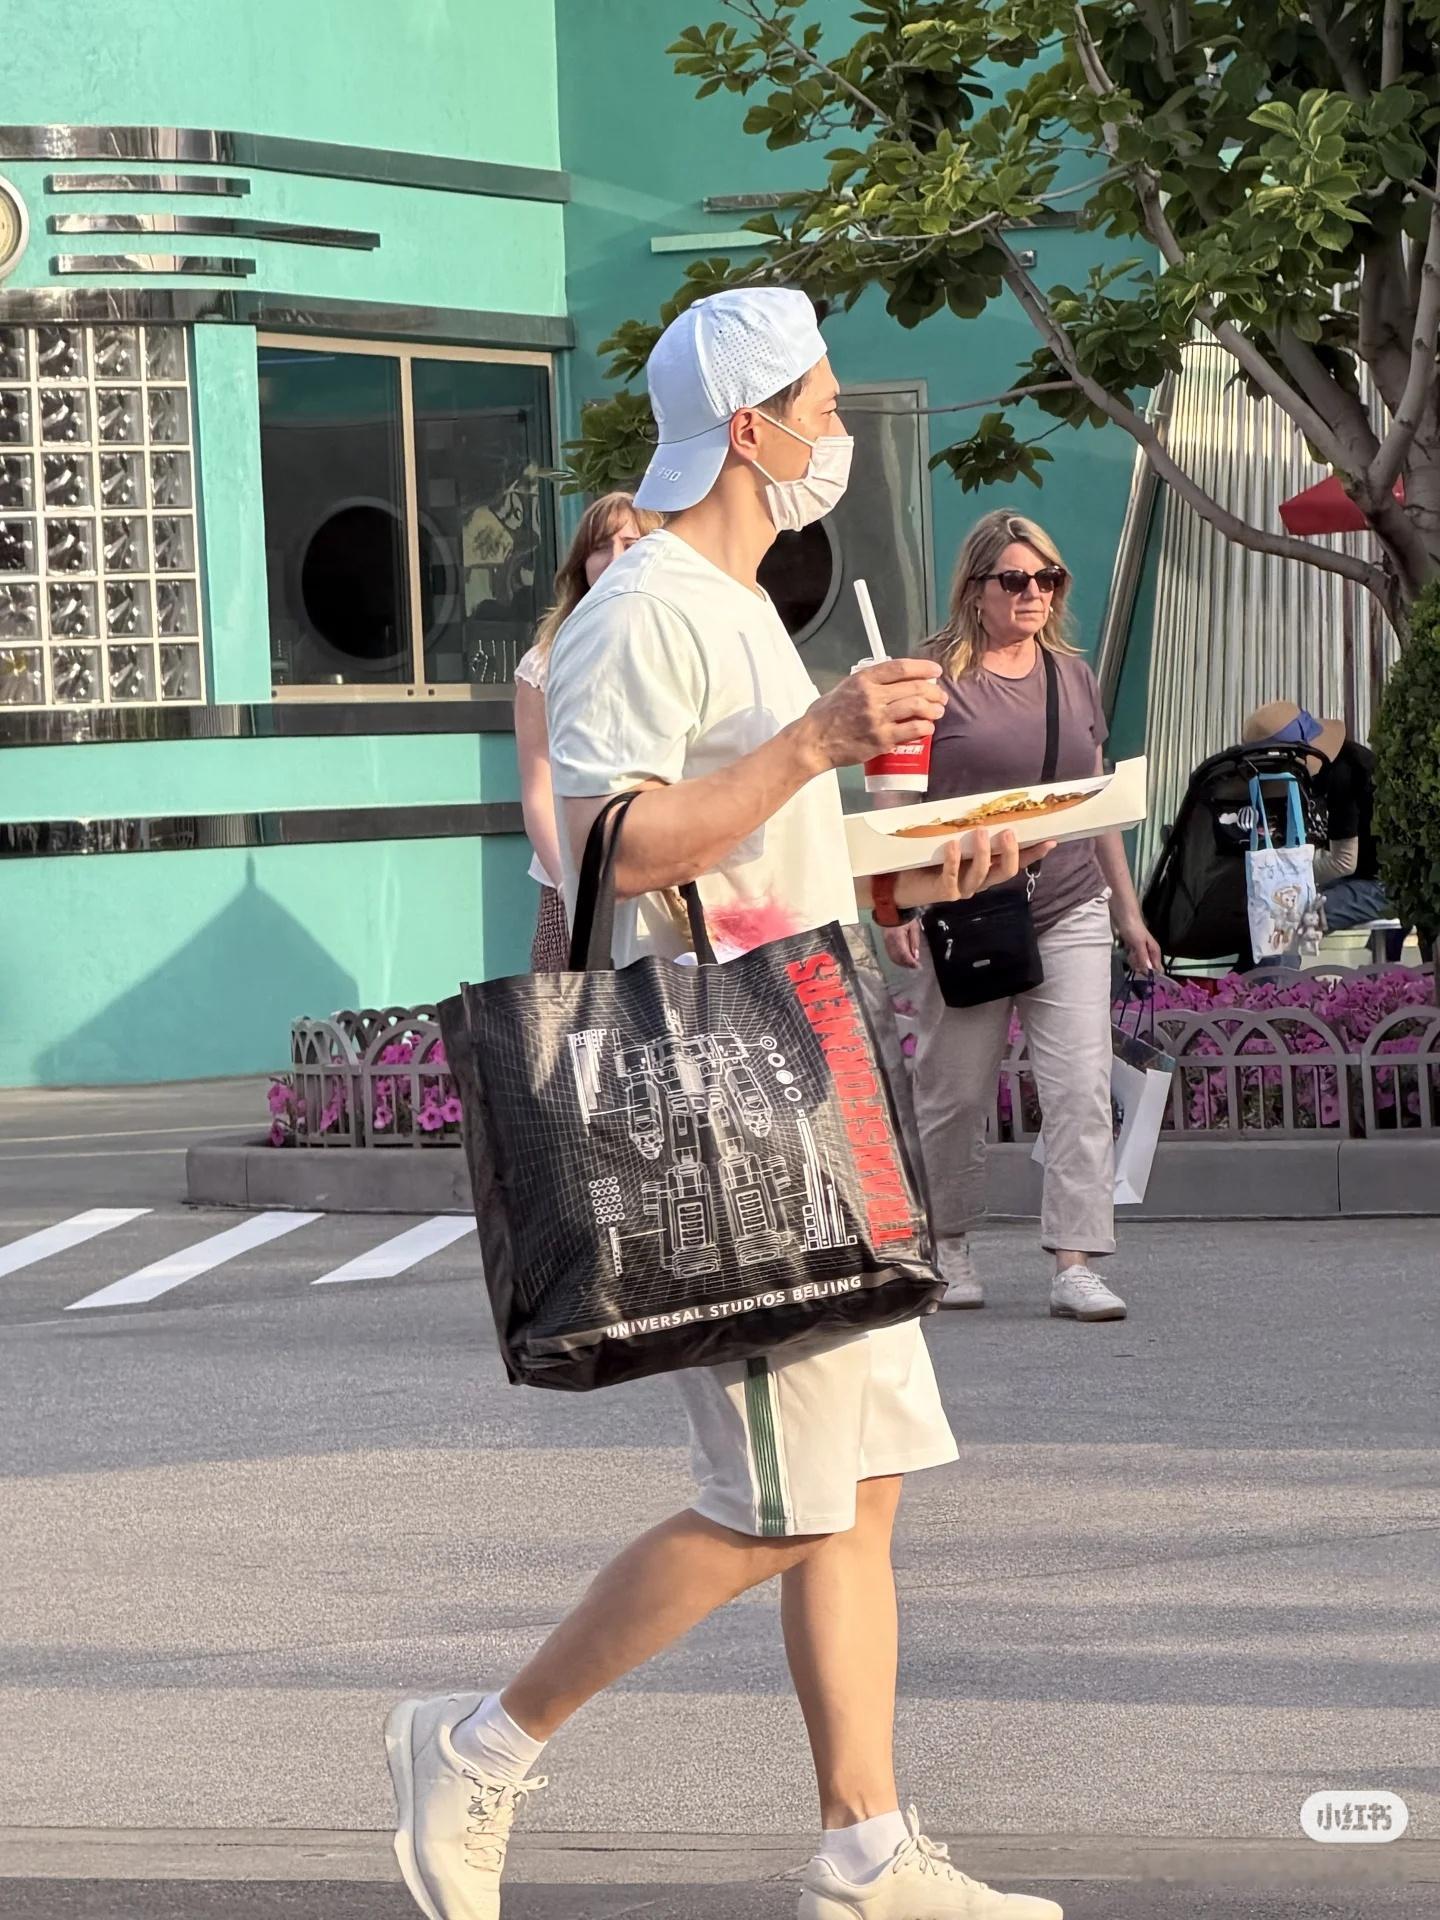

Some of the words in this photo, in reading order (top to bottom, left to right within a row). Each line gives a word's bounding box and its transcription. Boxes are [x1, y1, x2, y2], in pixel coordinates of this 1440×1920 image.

[784, 951, 914, 1249] TRANSFORMERS
[606, 1309, 704, 1340] UNIVERSAL
[709, 1291, 786, 1318] STUDIOS
[792, 1275, 862, 1301] BEIJING
